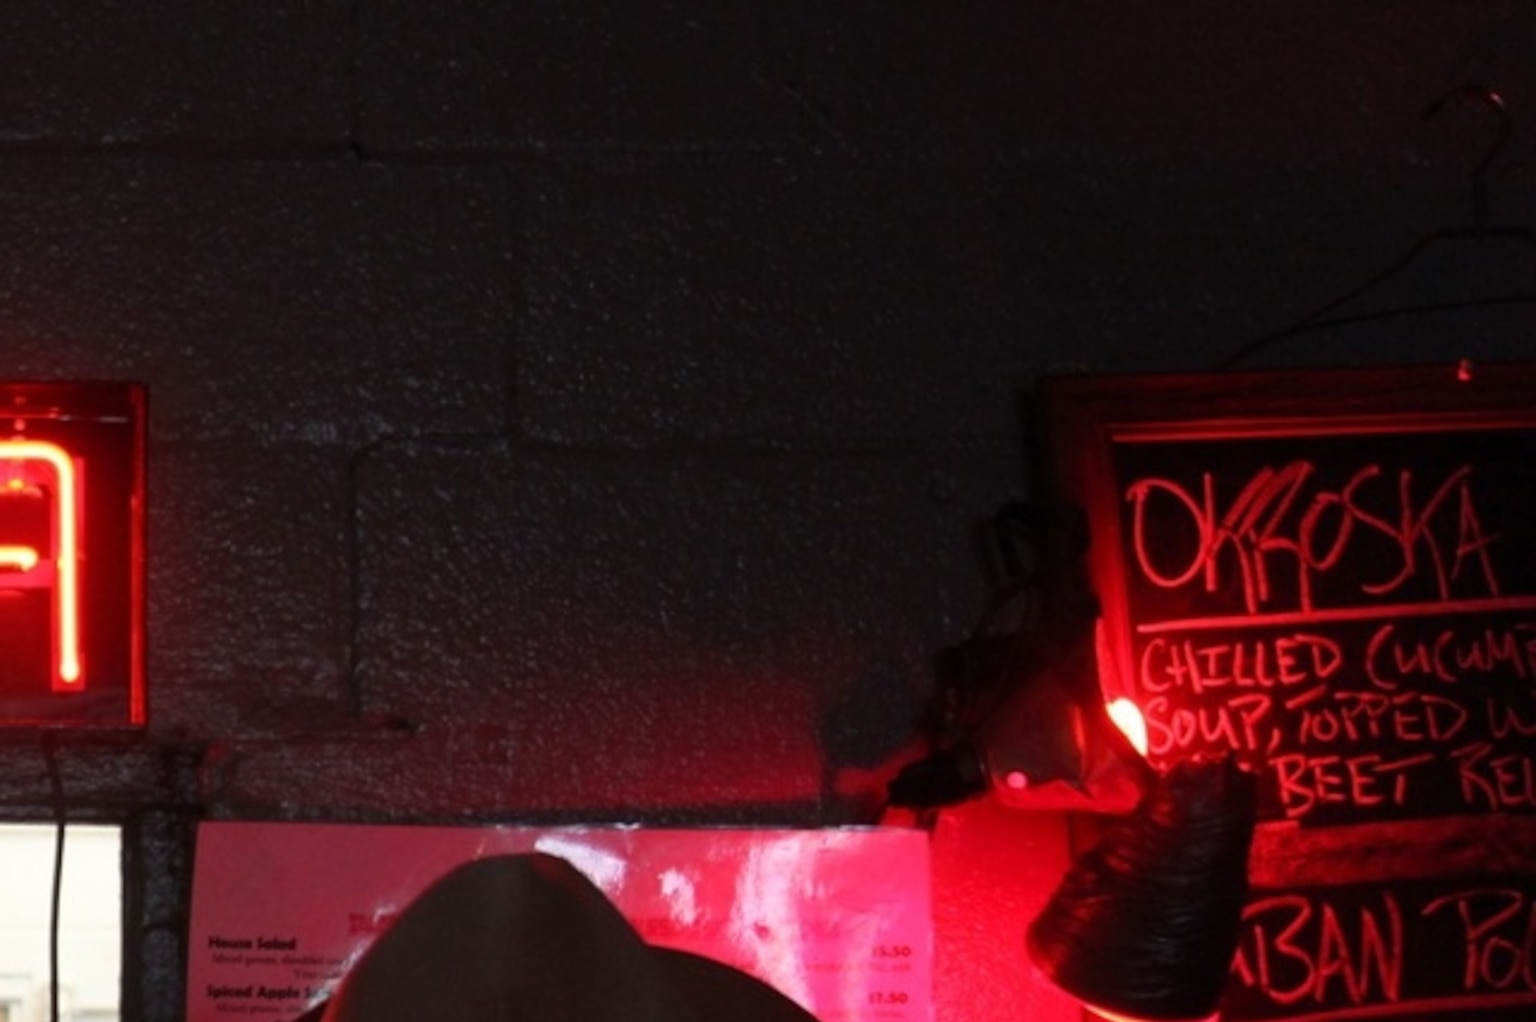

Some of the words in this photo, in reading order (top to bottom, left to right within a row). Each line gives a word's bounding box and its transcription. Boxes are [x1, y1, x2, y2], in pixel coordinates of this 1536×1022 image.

[1140, 633, 1343, 694] CHILLED
[1144, 694, 1280, 756] SOUP,
[1285, 685, 1467, 745] TOPPED
[1268, 753, 1435, 818] BEET
[208, 936, 252, 950] House
[257, 936, 296, 951] Salad
[1230, 889, 1403, 1003] BAN
[207, 984, 252, 999] Spiced
[257, 985, 299, 1000] Apple
